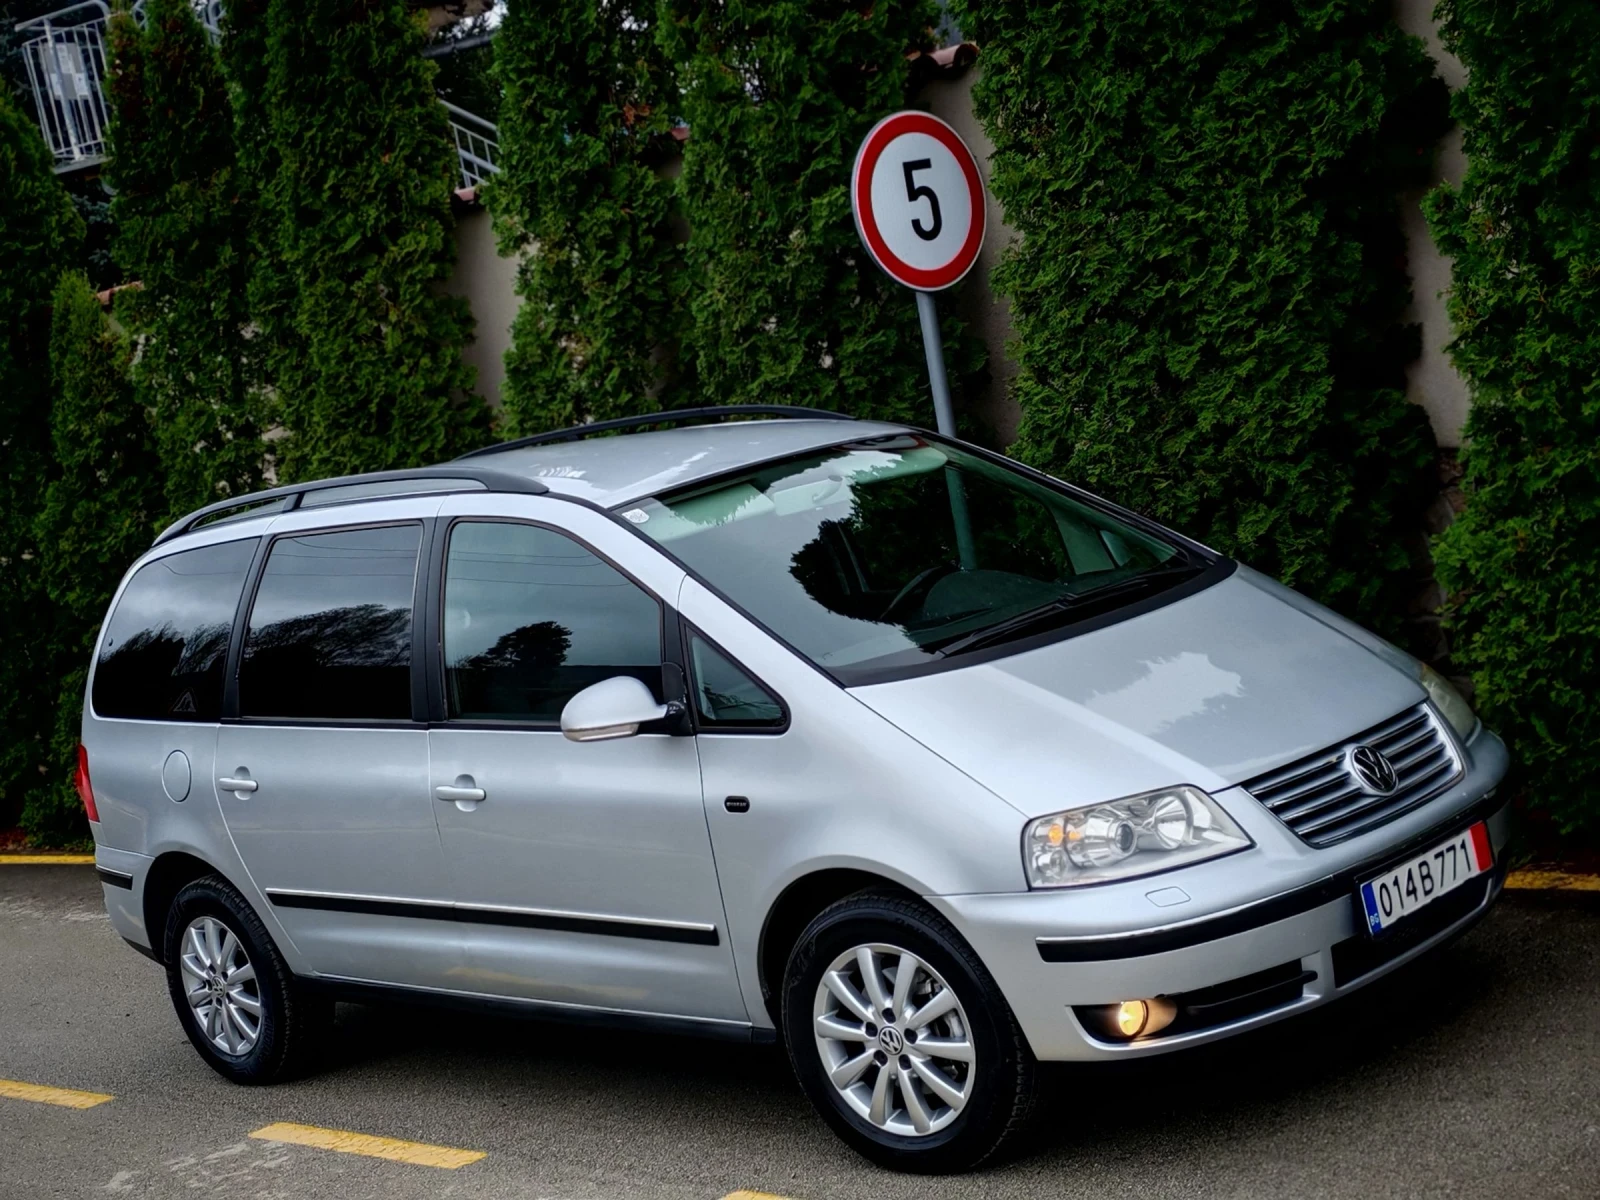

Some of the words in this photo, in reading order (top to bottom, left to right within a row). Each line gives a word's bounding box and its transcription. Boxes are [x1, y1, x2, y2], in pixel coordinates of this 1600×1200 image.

[902, 158, 943, 241] 5
[1379, 838, 1472, 917] 014B771
[1369, 912, 1380, 927] BG
